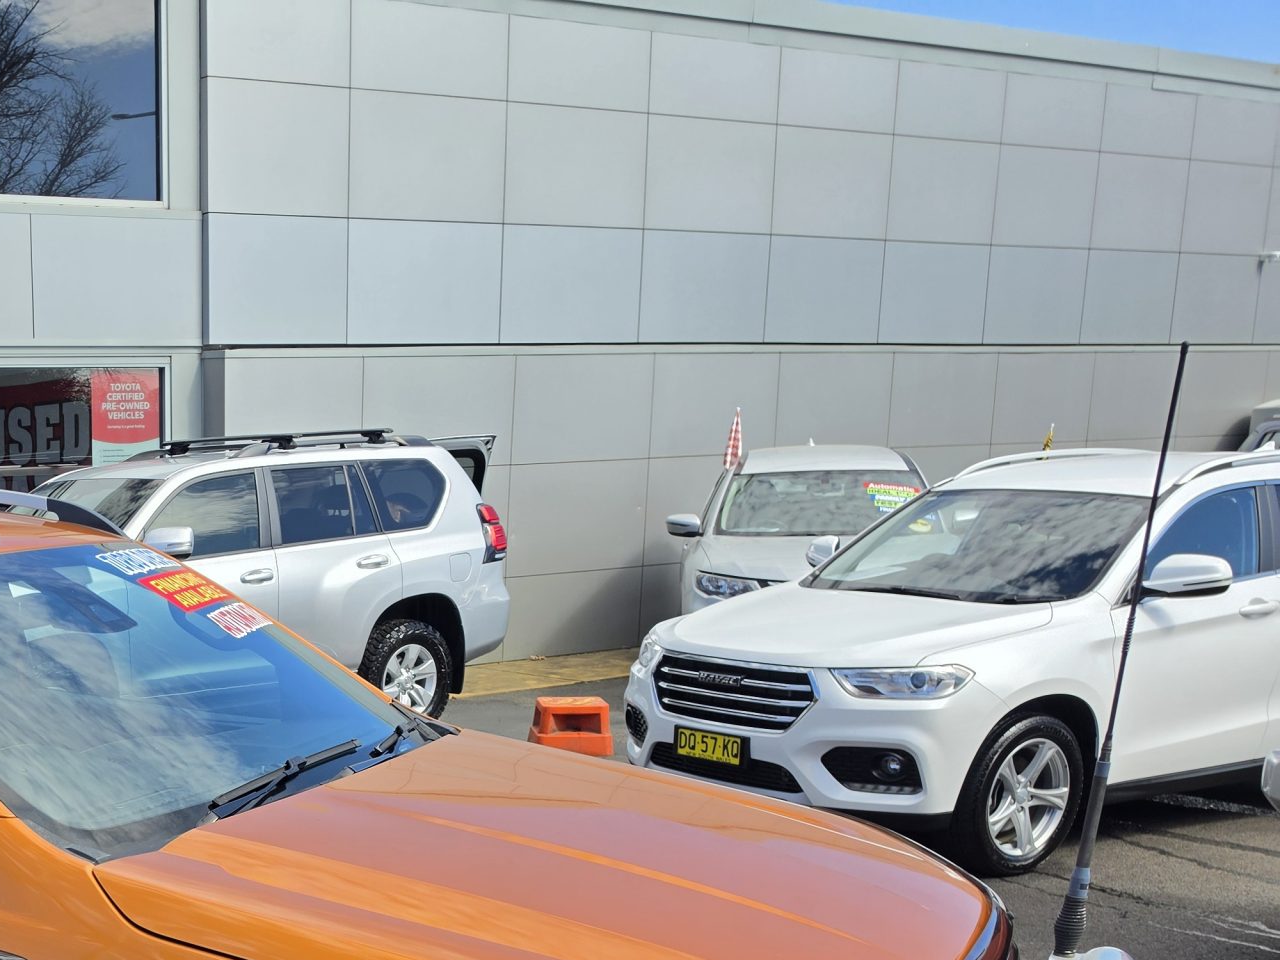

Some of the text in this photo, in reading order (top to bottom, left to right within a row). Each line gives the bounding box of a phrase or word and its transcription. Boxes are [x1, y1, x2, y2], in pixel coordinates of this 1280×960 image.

[110, 383, 141, 391] TOYOTA
[106, 392, 145, 401] CERTIFIED
[102, 402, 150, 410] PRE-OWNED
[107, 411, 145, 420] VEHICLES
[868, 483, 915, 493] Automatic
[174, 585, 227, 608] AVAILABLE
